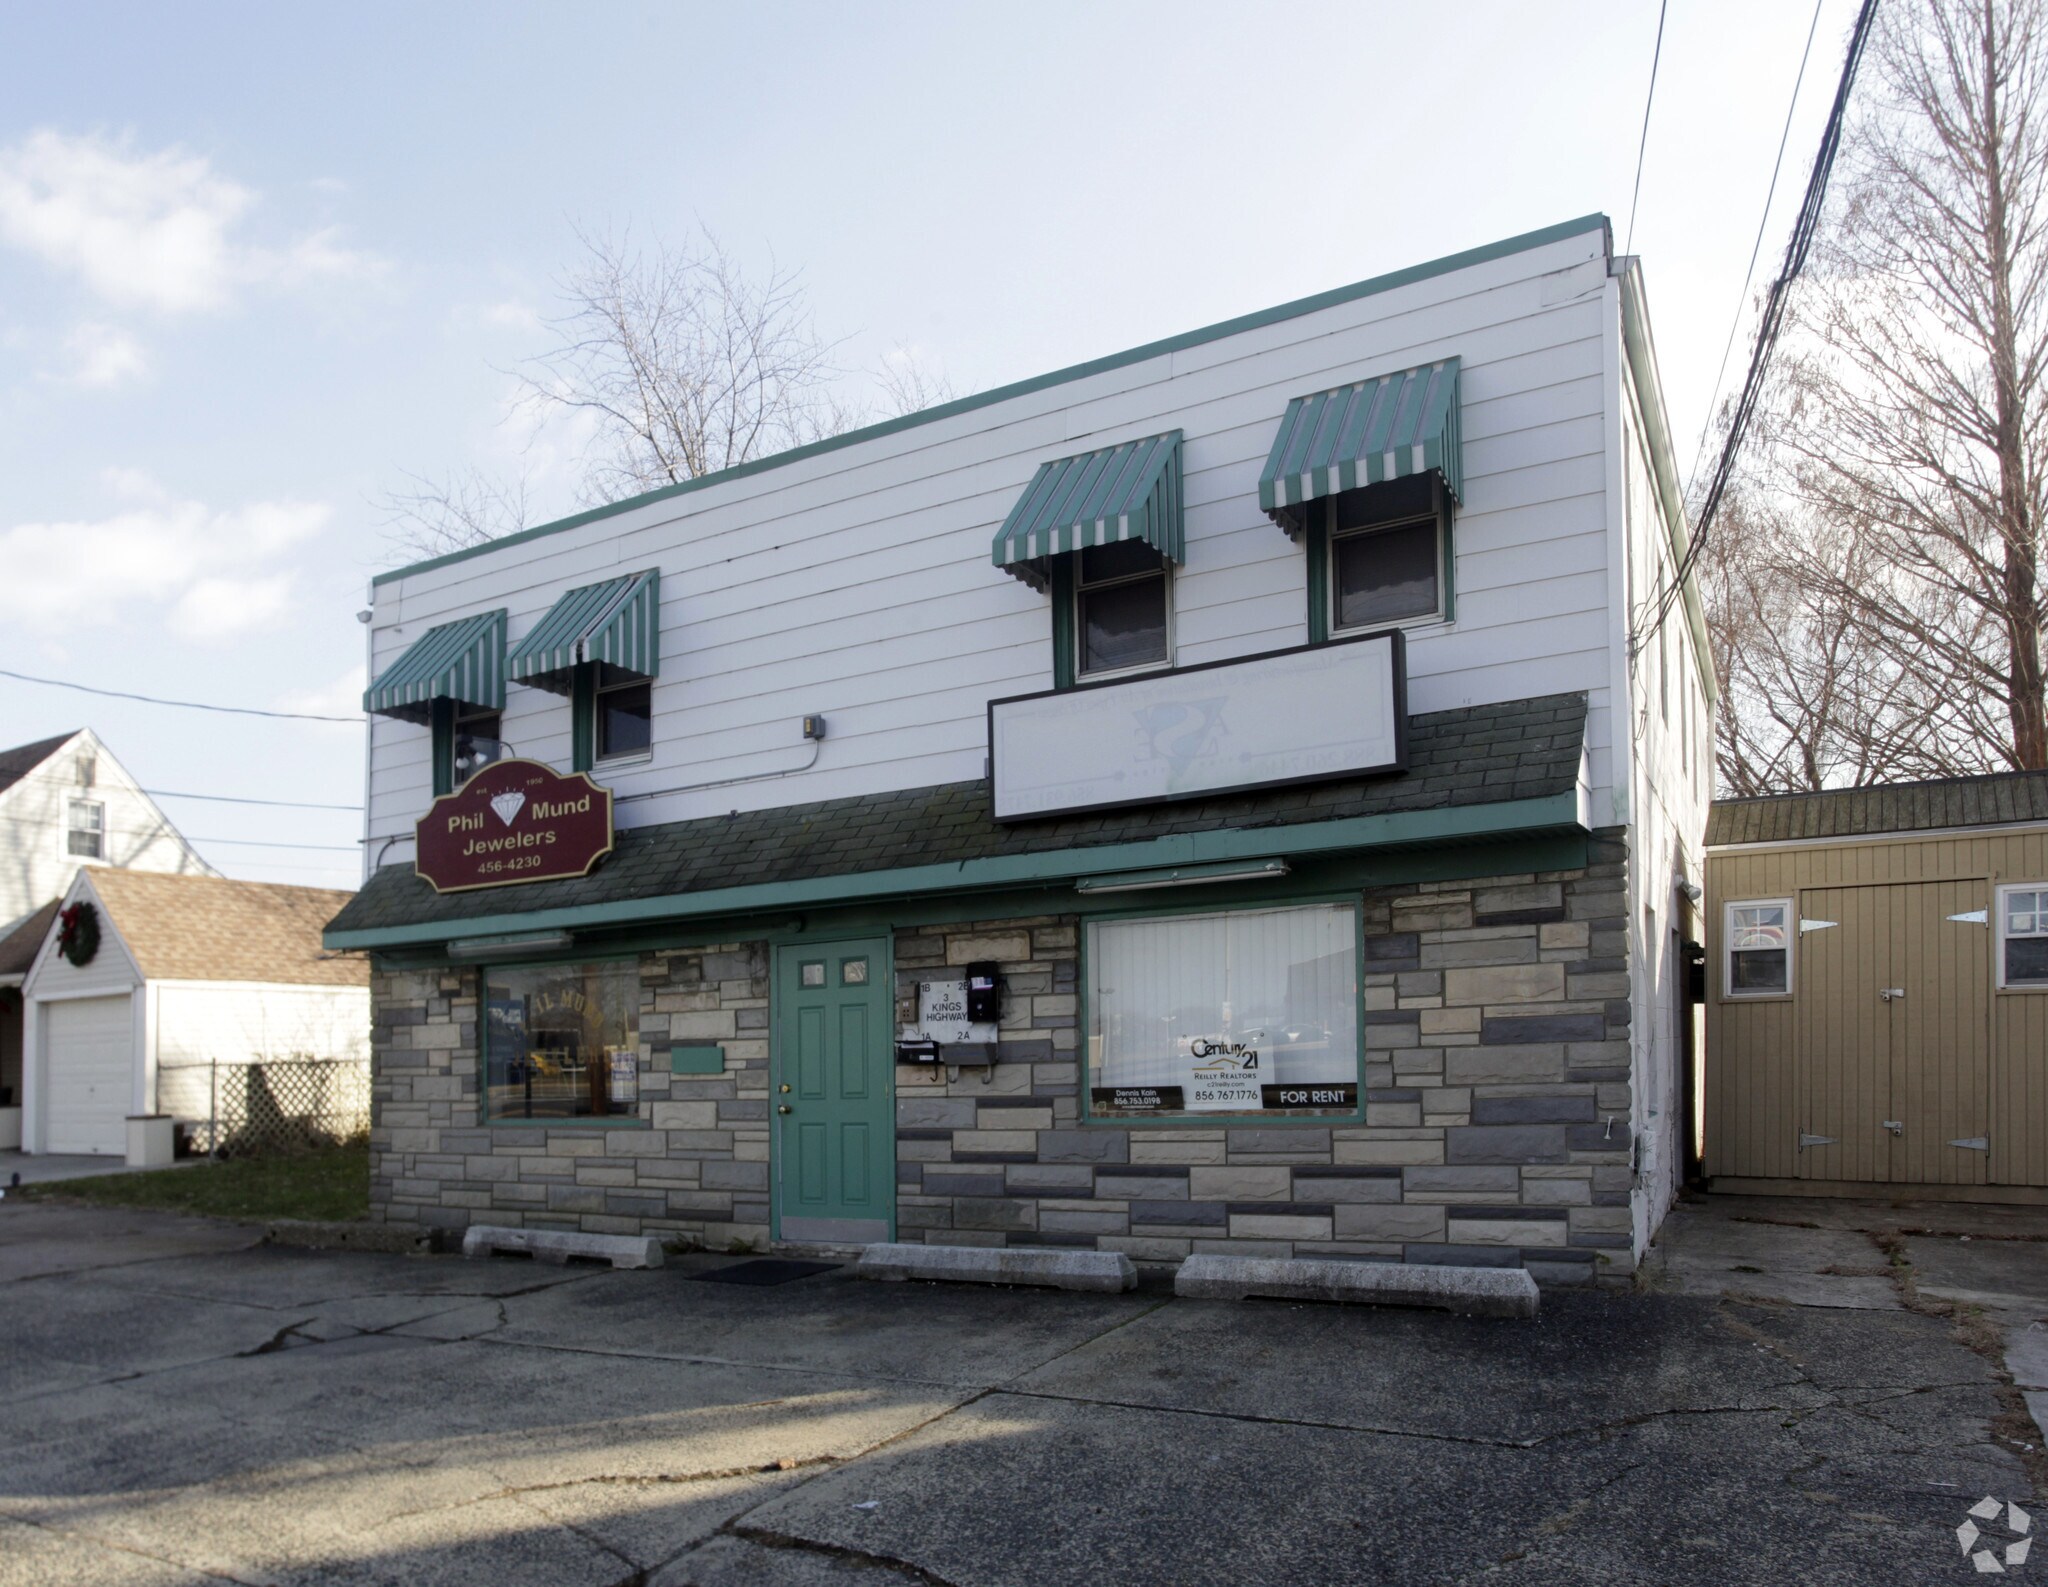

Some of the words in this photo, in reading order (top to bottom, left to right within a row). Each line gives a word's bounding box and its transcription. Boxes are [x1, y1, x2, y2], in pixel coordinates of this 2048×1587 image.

[448, 813, 484, 833] Phil
[532, 794, 590, 820] Mund
[463, 830, 557, 856] Jewelers
[477, 855, 541, 874] 456-4230
[921, 984, 931, 992] 1B
[943, 993, 949, 1002] 3
[932, 1002, 961, 1012] KINGS
[926, 1012, 968, 1021] HIGHWAY
[922, 1032, 932, 1041] 1A
[1191, 1039, 1247, 1058] Century
[1242, 1051, 1259, 1070] 21
[1194, 1072, 1218, 1080] REILLY
[1220, 1072, 1257, 1080] REALTORS
[1116, 1089, 1140, 1097] Dennis
[1195, 1090, 1258, 1101] 856.767.1776
[1280, 1091, 1308, 1103] FOR
[1312, 1090, 1345, 1103] RENT
